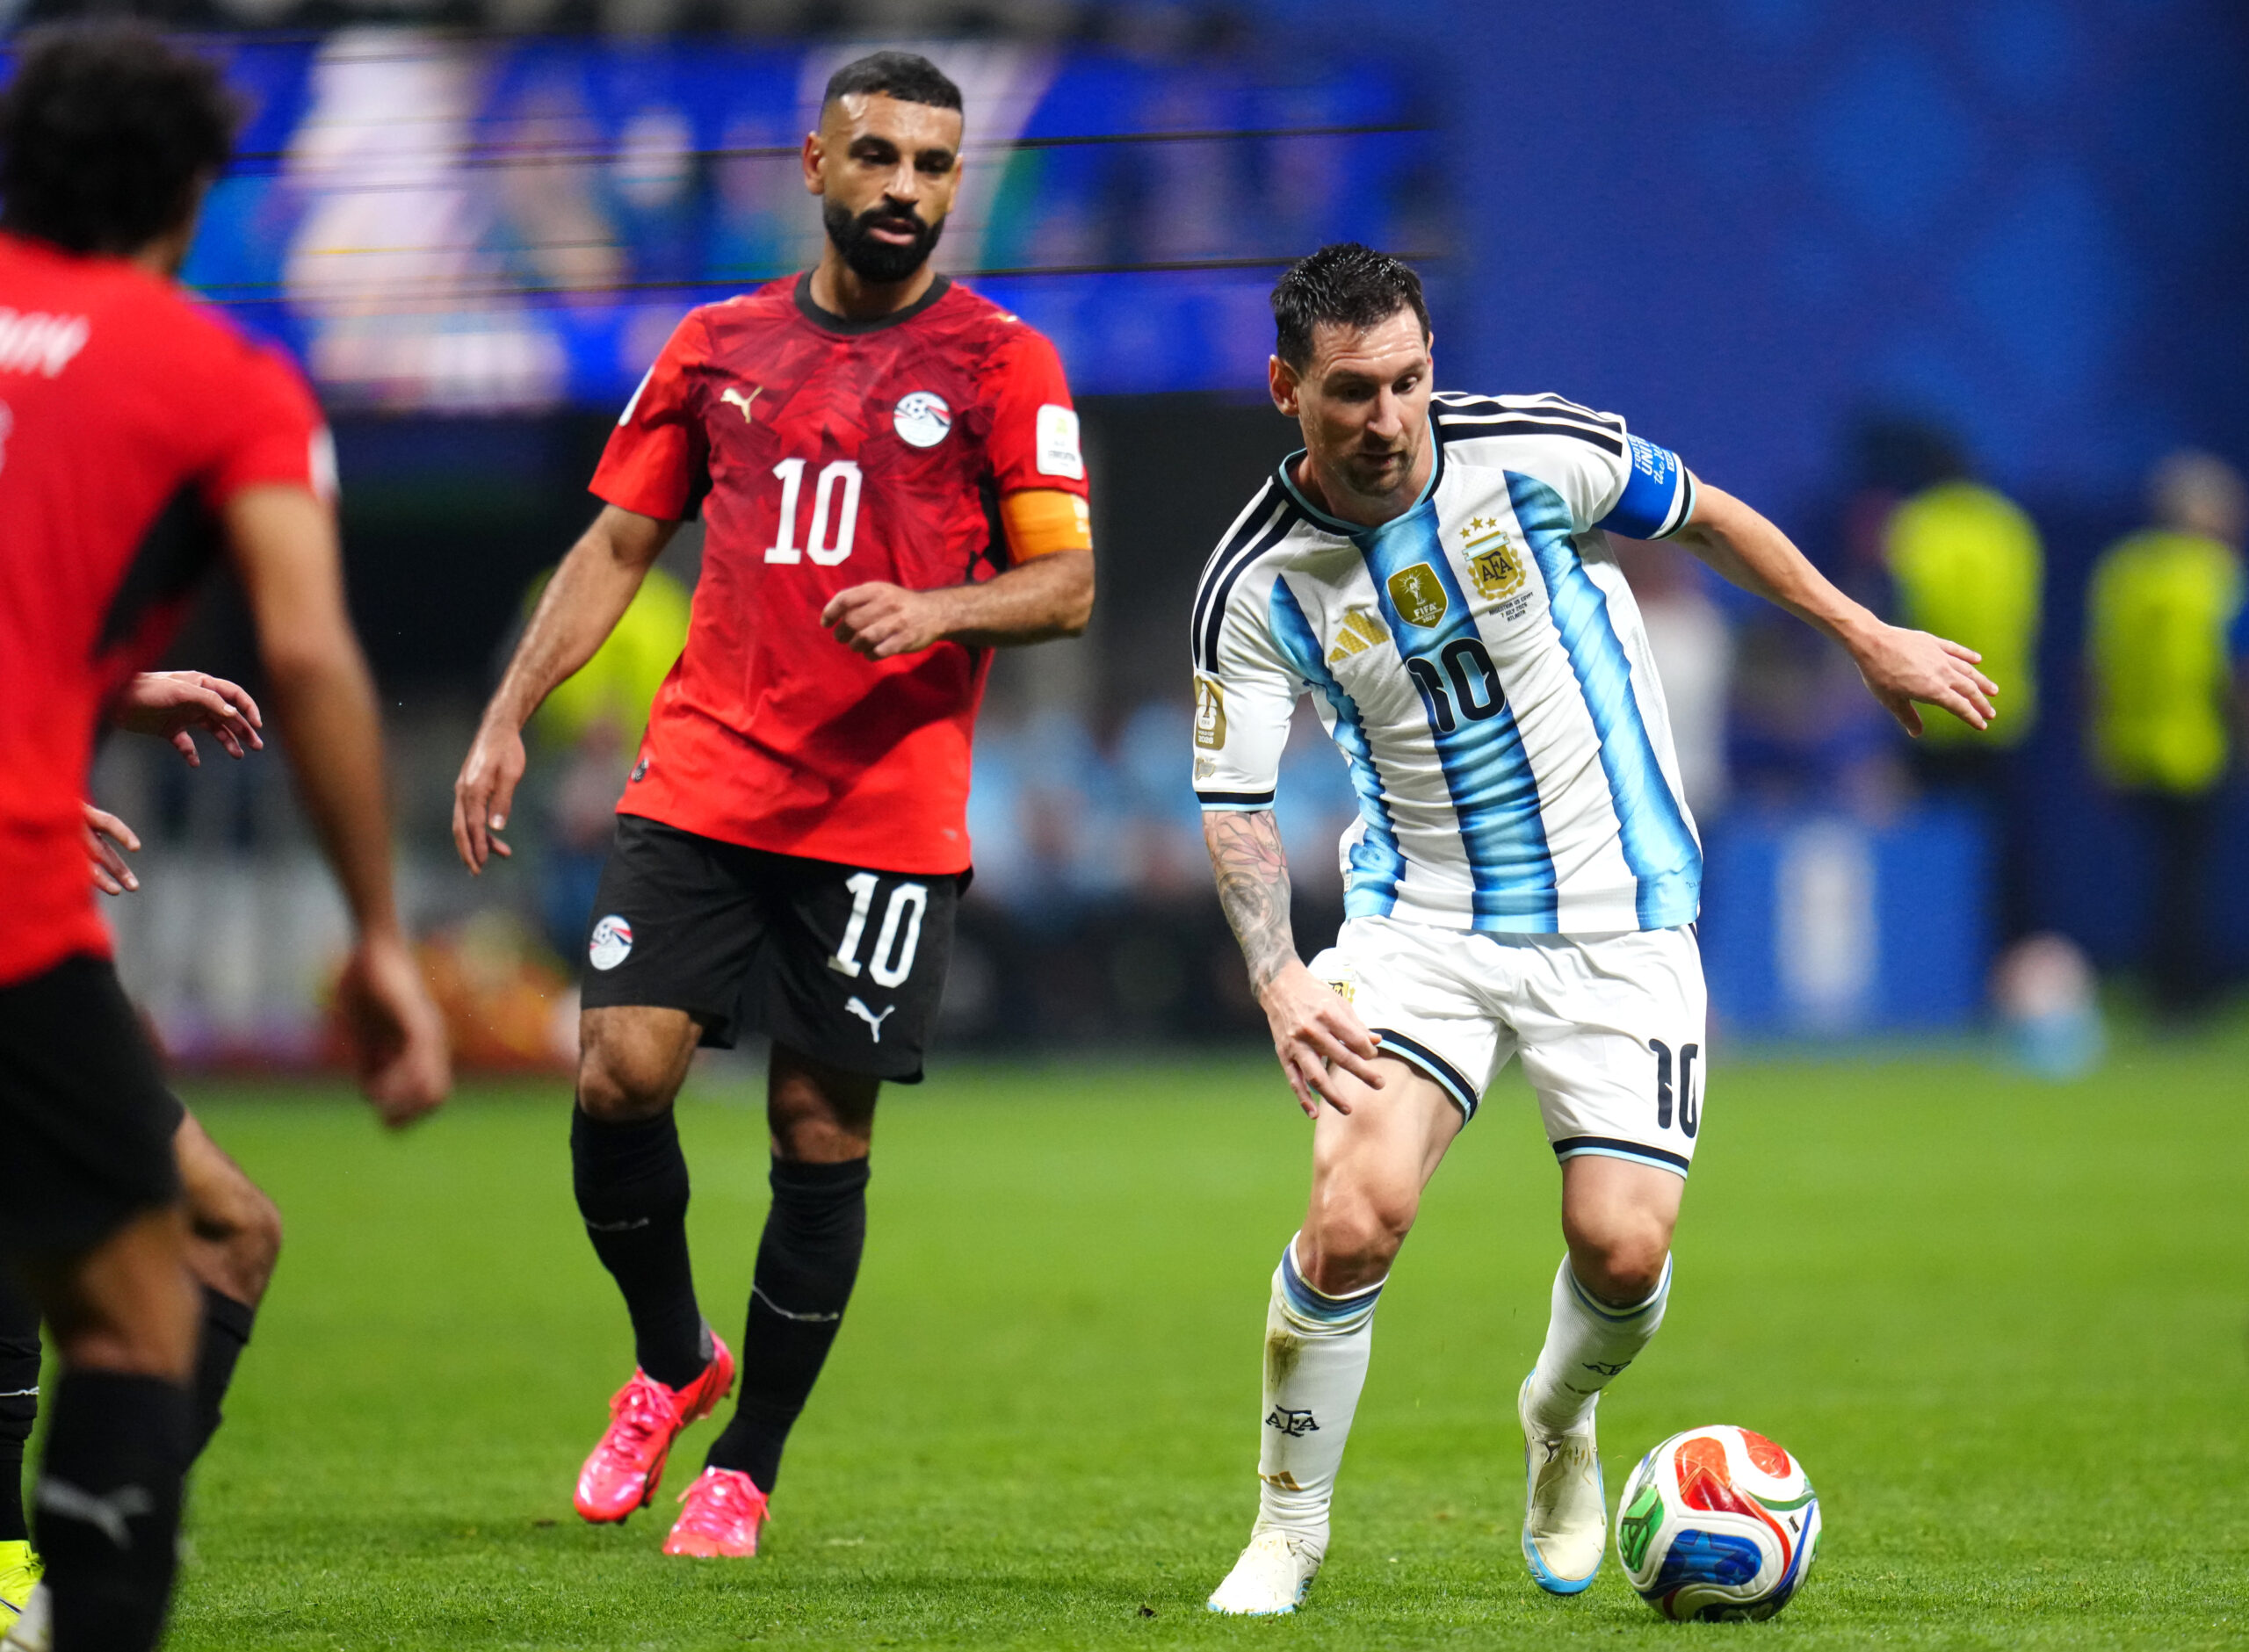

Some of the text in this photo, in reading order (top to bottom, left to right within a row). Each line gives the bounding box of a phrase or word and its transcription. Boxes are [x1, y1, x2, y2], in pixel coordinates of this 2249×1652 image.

[1653, 461, 1665, 485] the
[763, 457, 864, 566] 10
[1479, 551, 1514, 582] AFA
[1414, 603, 1437, 617] FIFA
[1406, 637, 1507, 733] 10
[828, 870, 928, 989] 10
[1648, 1038, 1699, 1139] 10
[1265, 1403, 1320, 1438] AFA
